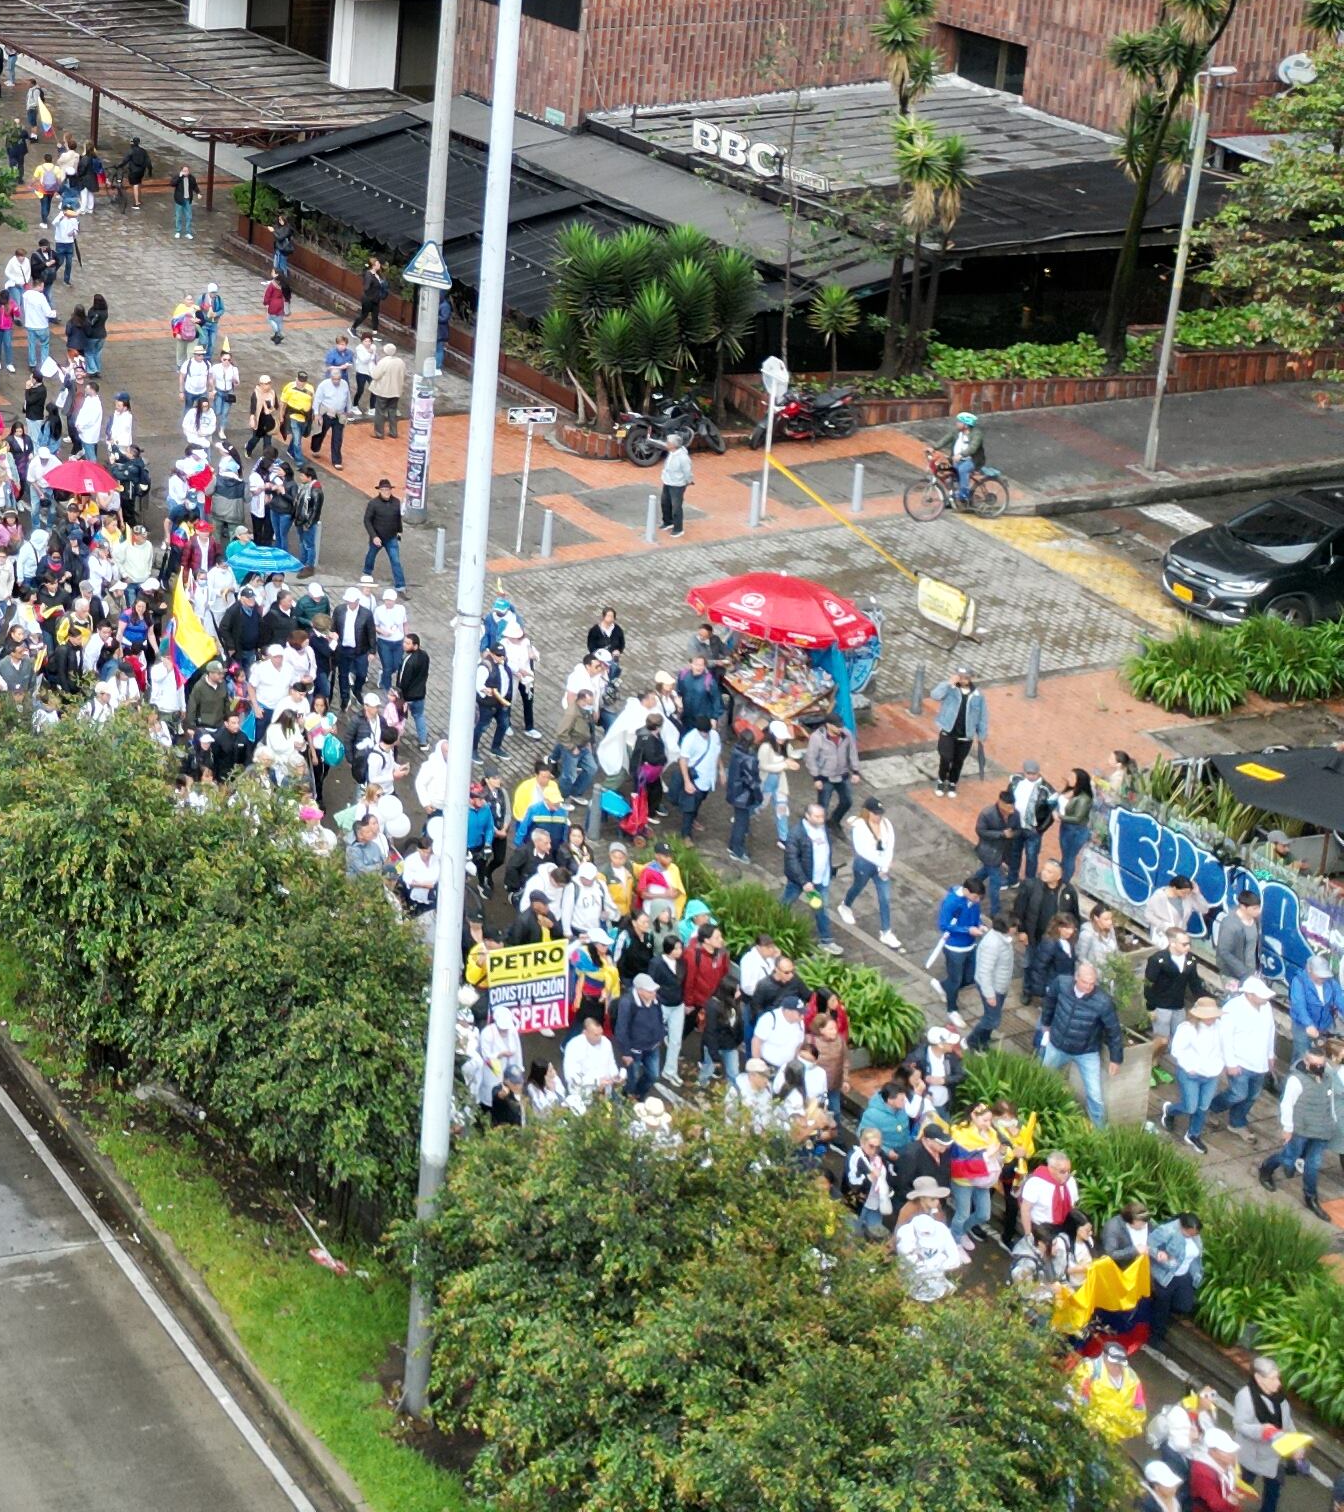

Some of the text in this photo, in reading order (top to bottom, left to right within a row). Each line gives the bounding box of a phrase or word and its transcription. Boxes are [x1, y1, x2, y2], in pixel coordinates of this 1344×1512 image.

[692, 118, 781, 178] BBC
[490, 947, 564, 972] PETRO
[490, 975, 565, 1005] CONSTITUCIÓN
[512, 1001, 562, 1031] SPETA
